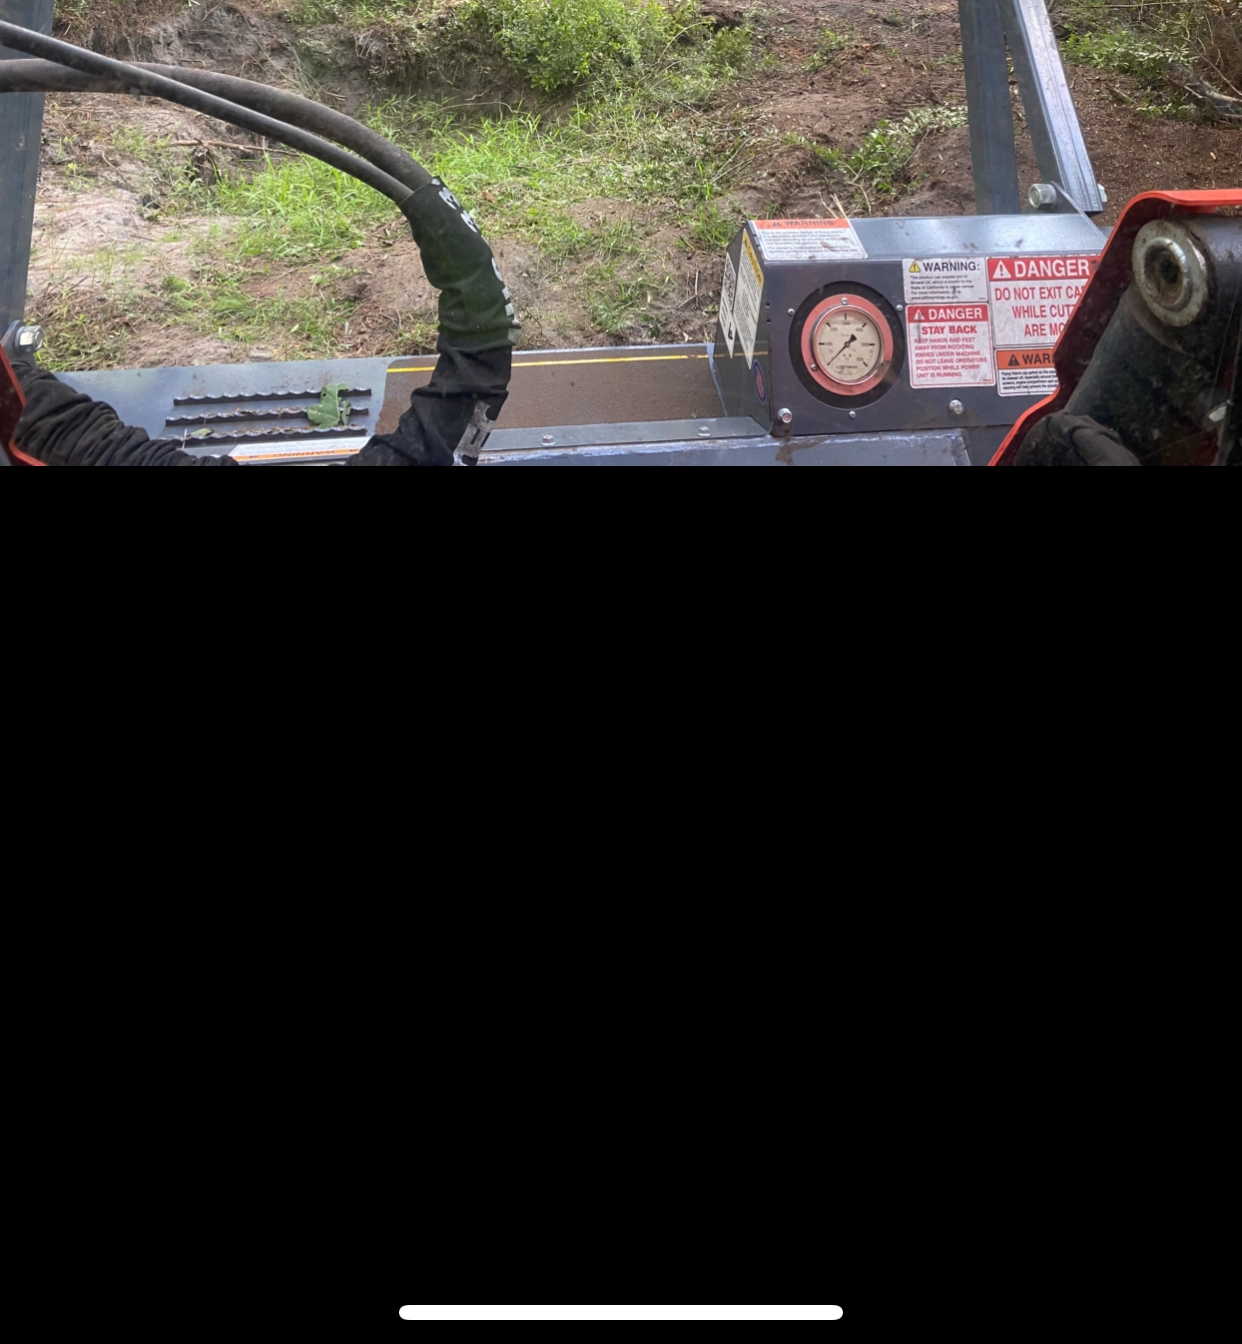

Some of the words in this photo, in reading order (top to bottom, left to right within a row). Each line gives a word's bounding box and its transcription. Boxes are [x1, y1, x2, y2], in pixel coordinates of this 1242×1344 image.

[923, 262, 980, 271] WARNING:
[1014, 260, 1090, 277] DANGER
[995, 288, 1010, 301] DO
[1014, 287, 1035, 300] NOT
[1039, 286, 1062, 299] EXIT
[928, 308, 983, 320] DANGER
[1012, 306, 1047, 318] WHILE
[1050, 304, 1075, 317] CUT
[922, 326, 945, 334] STAY
[949, 325, 977, 334] BACK
[1024, 324, 1046, 336] ARE
[1049, 323, 1066, 335] MO
[1022, 353, 1052, 364] WAR
